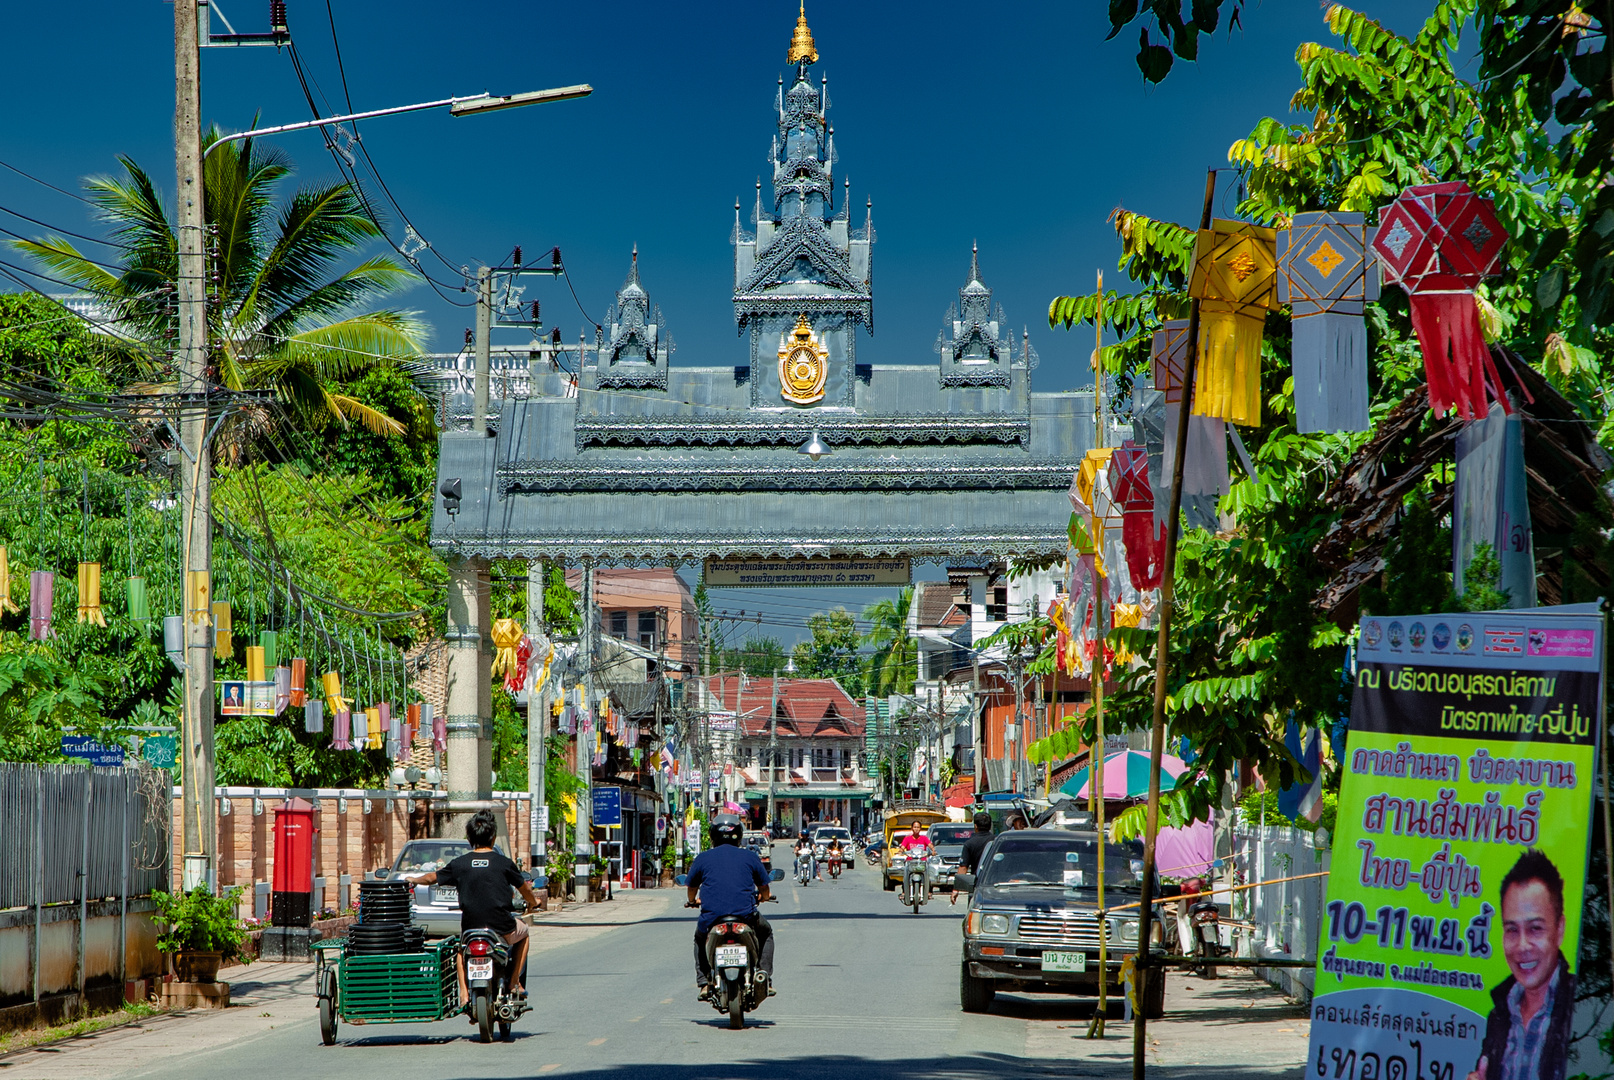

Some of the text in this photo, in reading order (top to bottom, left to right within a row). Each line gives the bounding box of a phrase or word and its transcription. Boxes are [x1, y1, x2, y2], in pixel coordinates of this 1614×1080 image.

[1358, 667, 1556, 701] ณ บริเวณอนุสรณ์สถาน
[1441, 704, 1590, 742] มิตรภาพไทย-ญี่ปุ่น
[1352, 741, 1460, 781] กาดล้านนา
[1363, 788, 1543, 845] สานสัมพันธ์
[1357, 839, 1482, 907] ไทย-ญี่ปุ่น
[472, 970, 489, 978] 487
[1061, 953, 1083, 964] 7938
[1322, 945, 1484, 990] ที่ขุนยวม จ.แม่ฮ่องสอน
